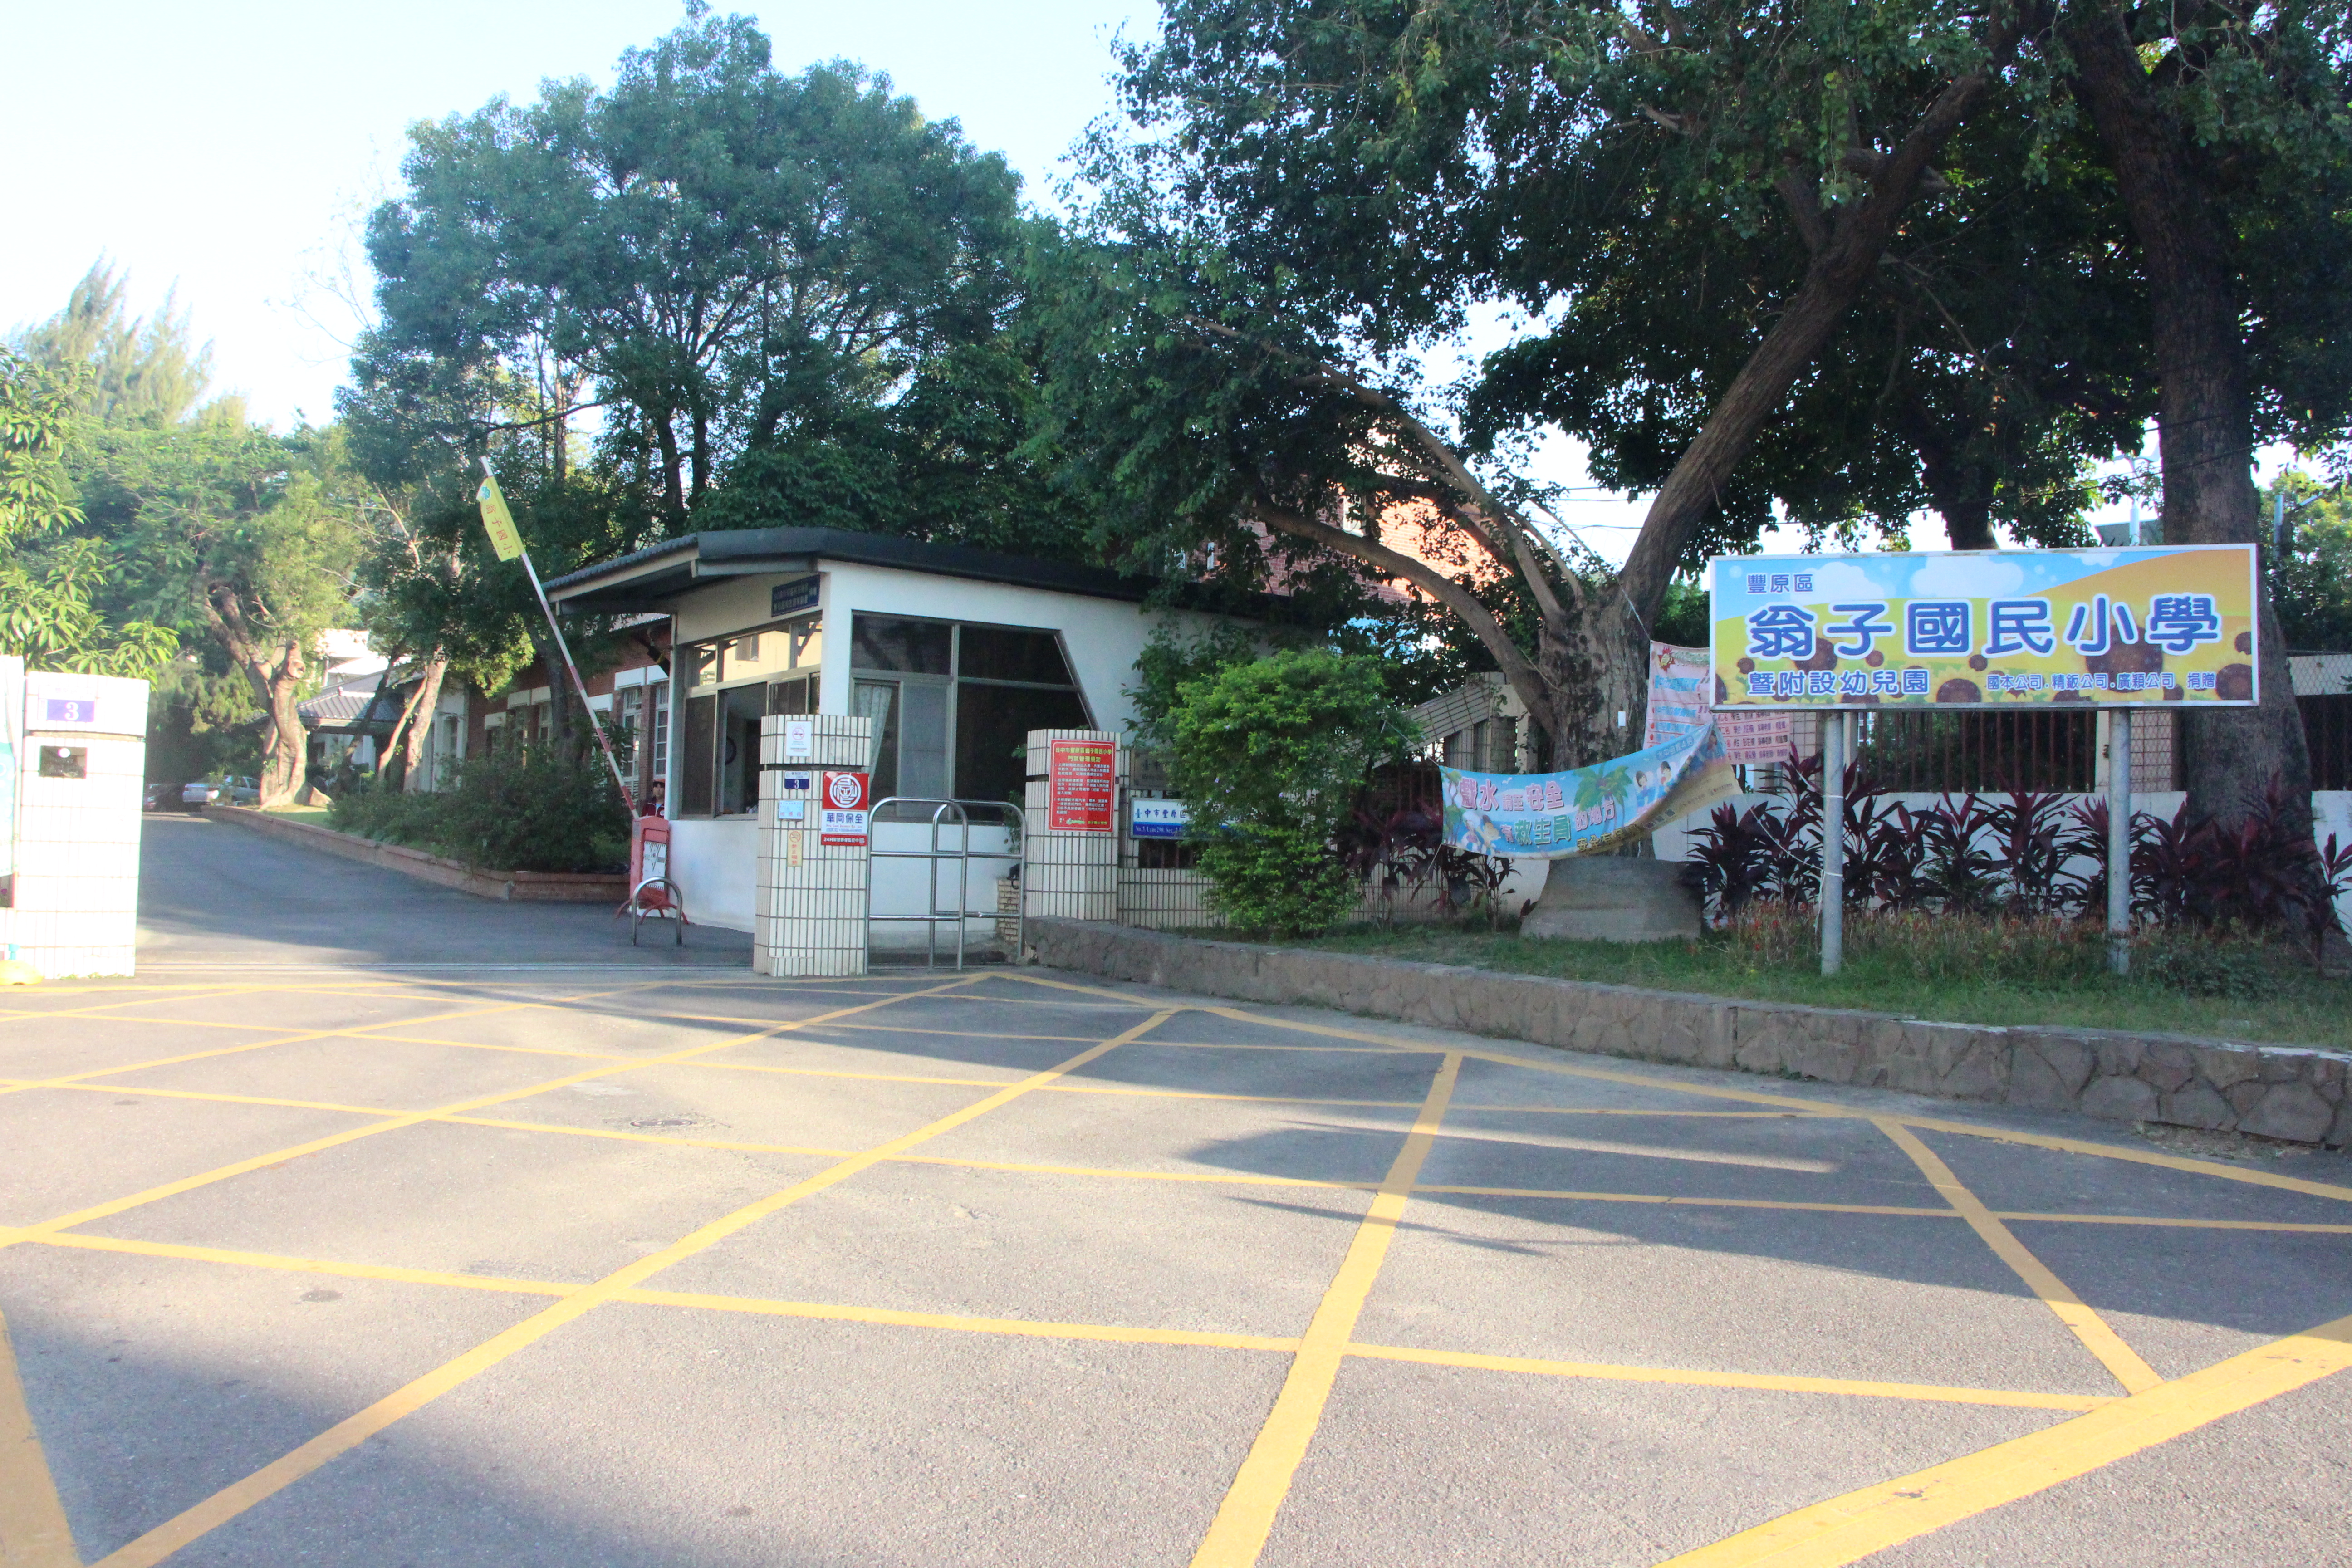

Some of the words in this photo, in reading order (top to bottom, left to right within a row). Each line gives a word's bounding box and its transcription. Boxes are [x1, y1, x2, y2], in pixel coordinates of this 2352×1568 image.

[486, 504, 513, 554] 翁子國小
[1747, 573, 1813, 594] 豐原區
[1749, 596, 2219, 657] 翁子國民小學
[1748, 670, 1930, 695] 暨附設幼兒園
[2187, 672, 2216, 689] 捐贈
[65, 702, 79, 720] 3
[794, 779, 799, 789] 3
[827, 813, 863, 824] 華岡保全
